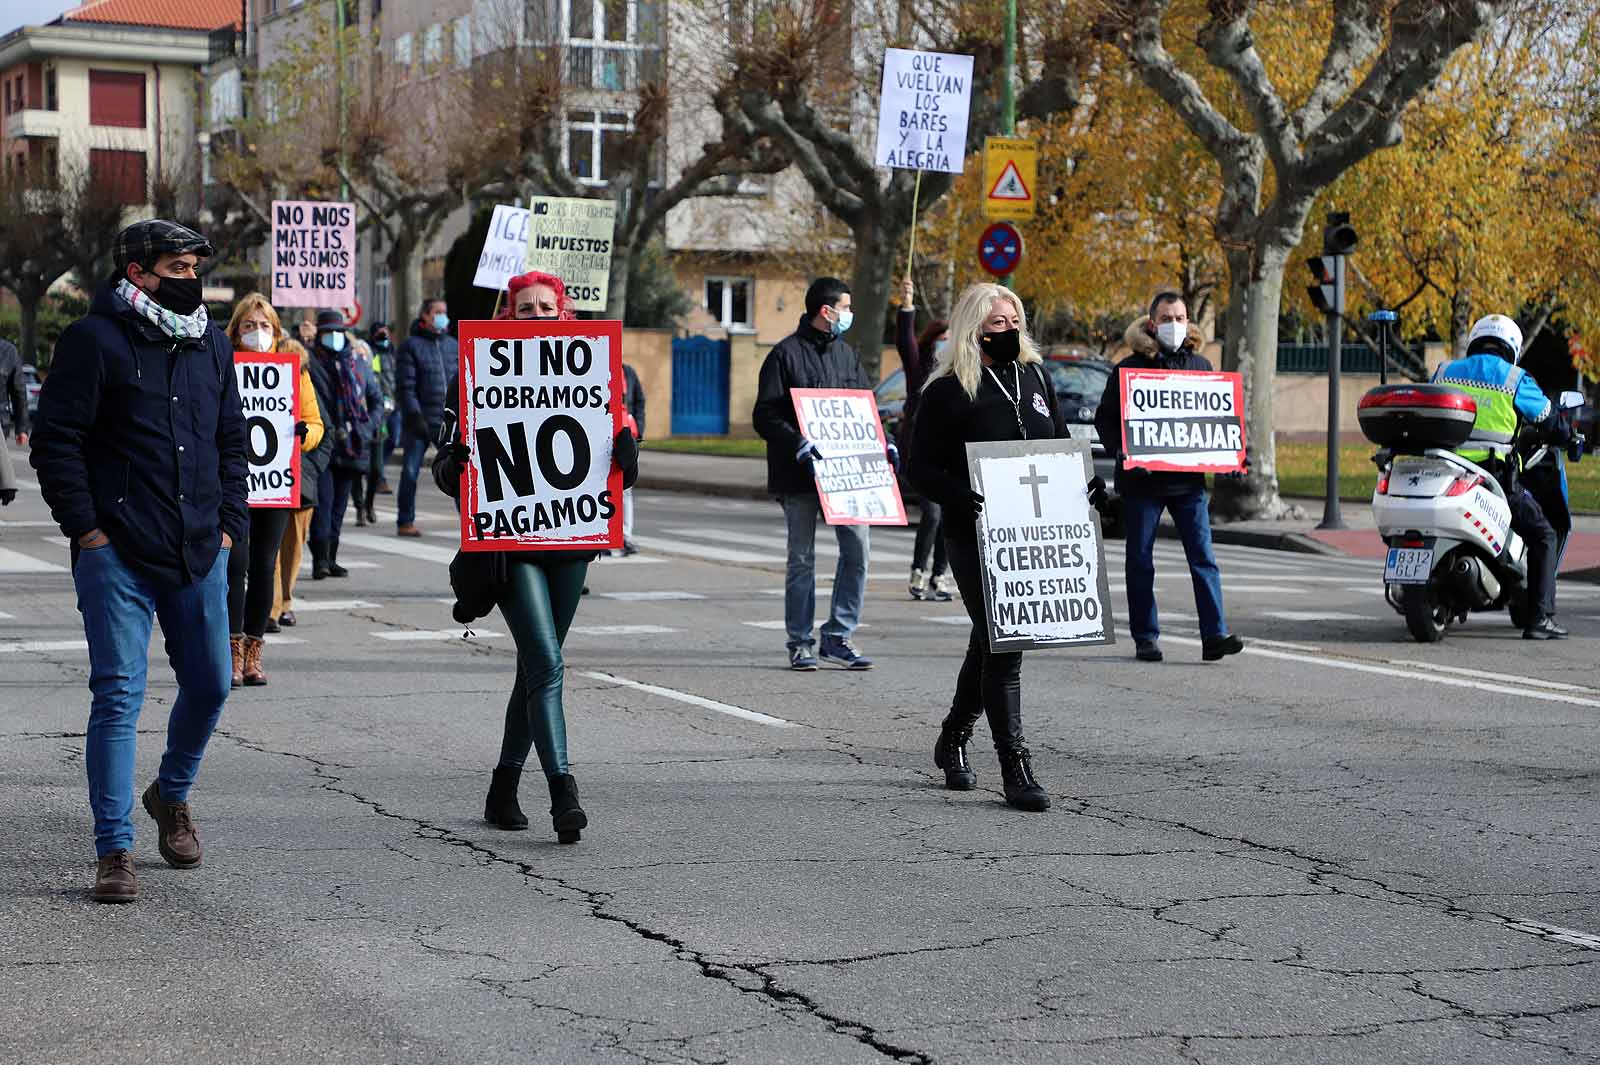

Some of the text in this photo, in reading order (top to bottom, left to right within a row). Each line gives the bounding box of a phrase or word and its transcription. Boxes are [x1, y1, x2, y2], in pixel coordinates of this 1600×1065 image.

[912, 55, 942, 73] QUE
[897, 71, 964, 95] VUELVAN
[915, 93, 940, 111] LOS
[900, 110, 948, 132] BARES
[899, 131, 943, 151] Y LA
[886, 149, 951, 170] ALEGRIA
[277, 206, 350, 227] NO NOS
[534, 202, 549, 216] NO
[494, 208, 529, 242] IGE
[535, 234, 610, 253] IMPUESTOS
[276, 250, 349, 269] NO SOMOS
[275, 272, 346, 290] EL VIRUS
[565, 286, 600, 302] ESOS
[489, 339, 593, 376] SI NO
[243, 365, 280, 390] NO
[241, 396, 293, 415] AMOS,
[472, 385, 610, 415] COBRAMOS,
[1133, 388, 1232, 412] QUEREMOS
[246, 415, 279, 467] O
[808, 421, 878, 441] CASADO
[1128, 420, 1242, 450] TRABAJAR
[475, 414, 591, 502] NO
[813, 456, 863, 477] MATAN
[865, 462, 873, 472] A
[819, 470, 894, 492] HOSTELEROS
[472, 490, 616, 541] PAGAMOS
[989, 523, 1091, 543] CON VUESTROS
[996, 543, 1091, 575] CIERRES,
[1398, 551, 1430, 564] 8312
[1395, 564, 1422, 577] GLF
[1004, 577, 1087, 598] NOS ESTAIS
[998, 597, 1098, 626] MATANDO
